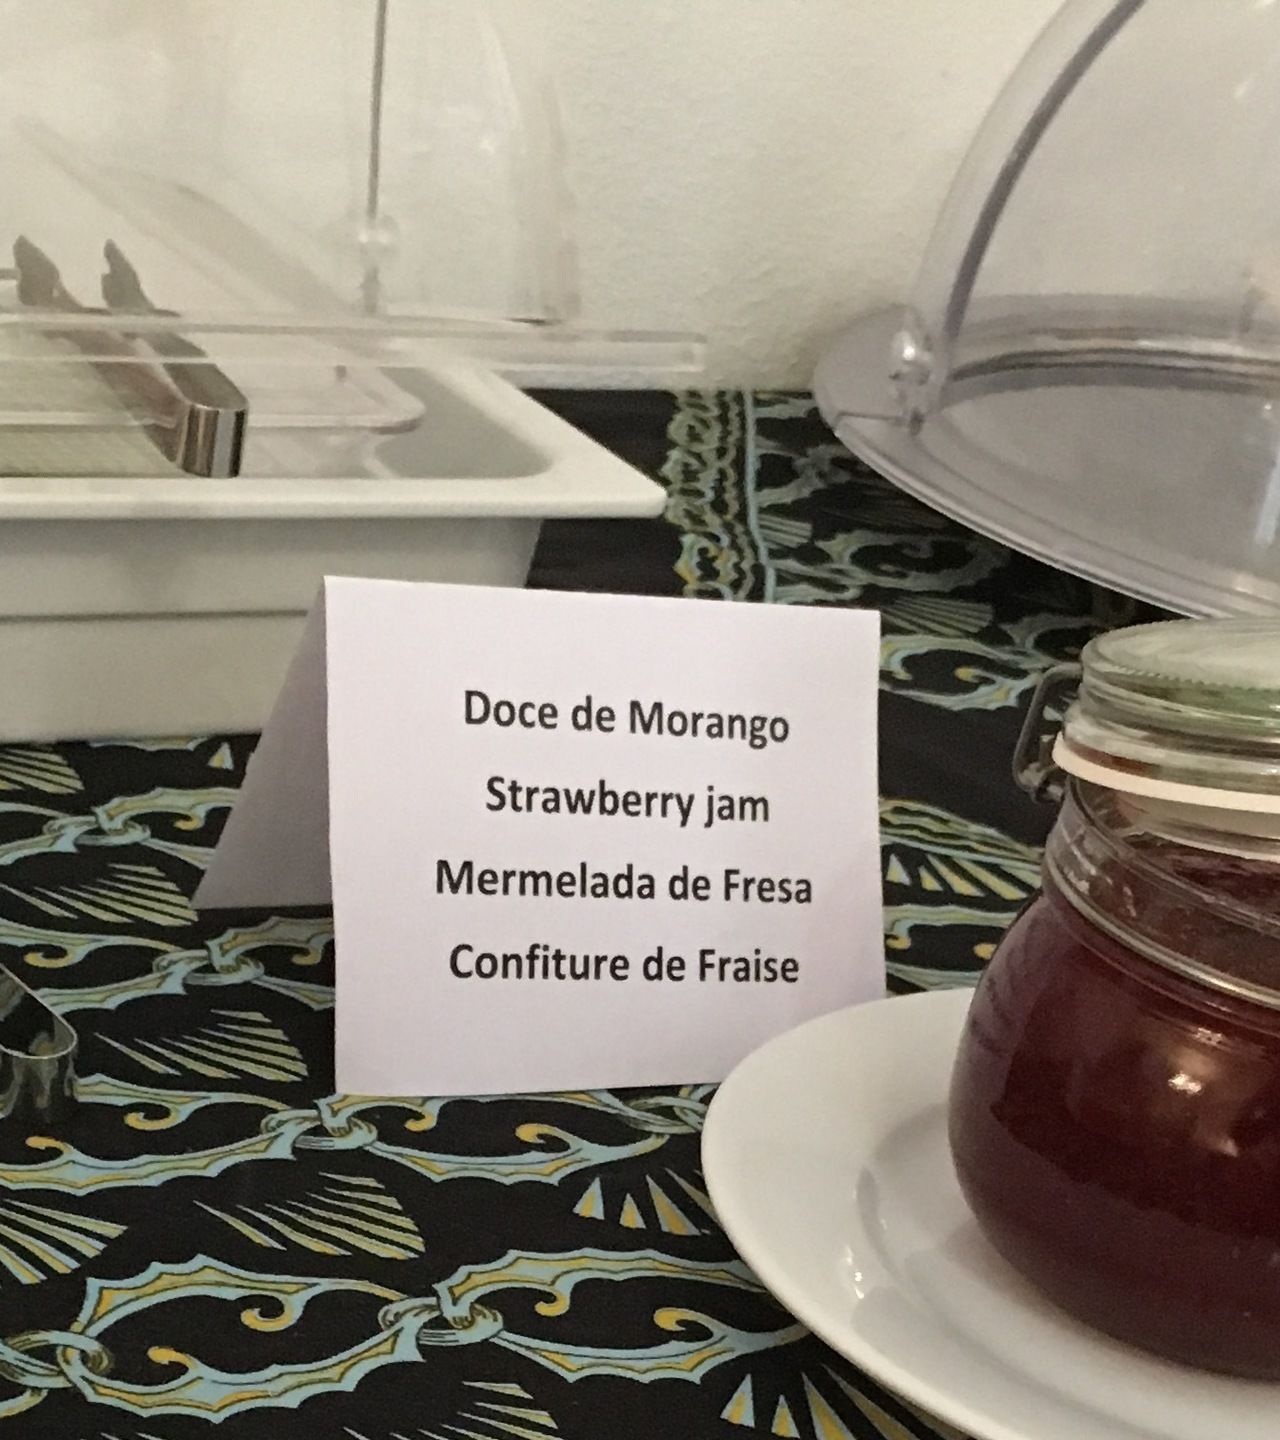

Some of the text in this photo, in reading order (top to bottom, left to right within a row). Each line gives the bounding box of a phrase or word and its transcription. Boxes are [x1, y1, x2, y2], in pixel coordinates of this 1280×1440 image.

[464, 689, 791, 751] Doce de Morango
[485, 774, 770, 830] Strawberry jam
[435, 858, 813, 906] Mermelada de Fresa
[448, 941, 801, 985] Confiture de Fraise
